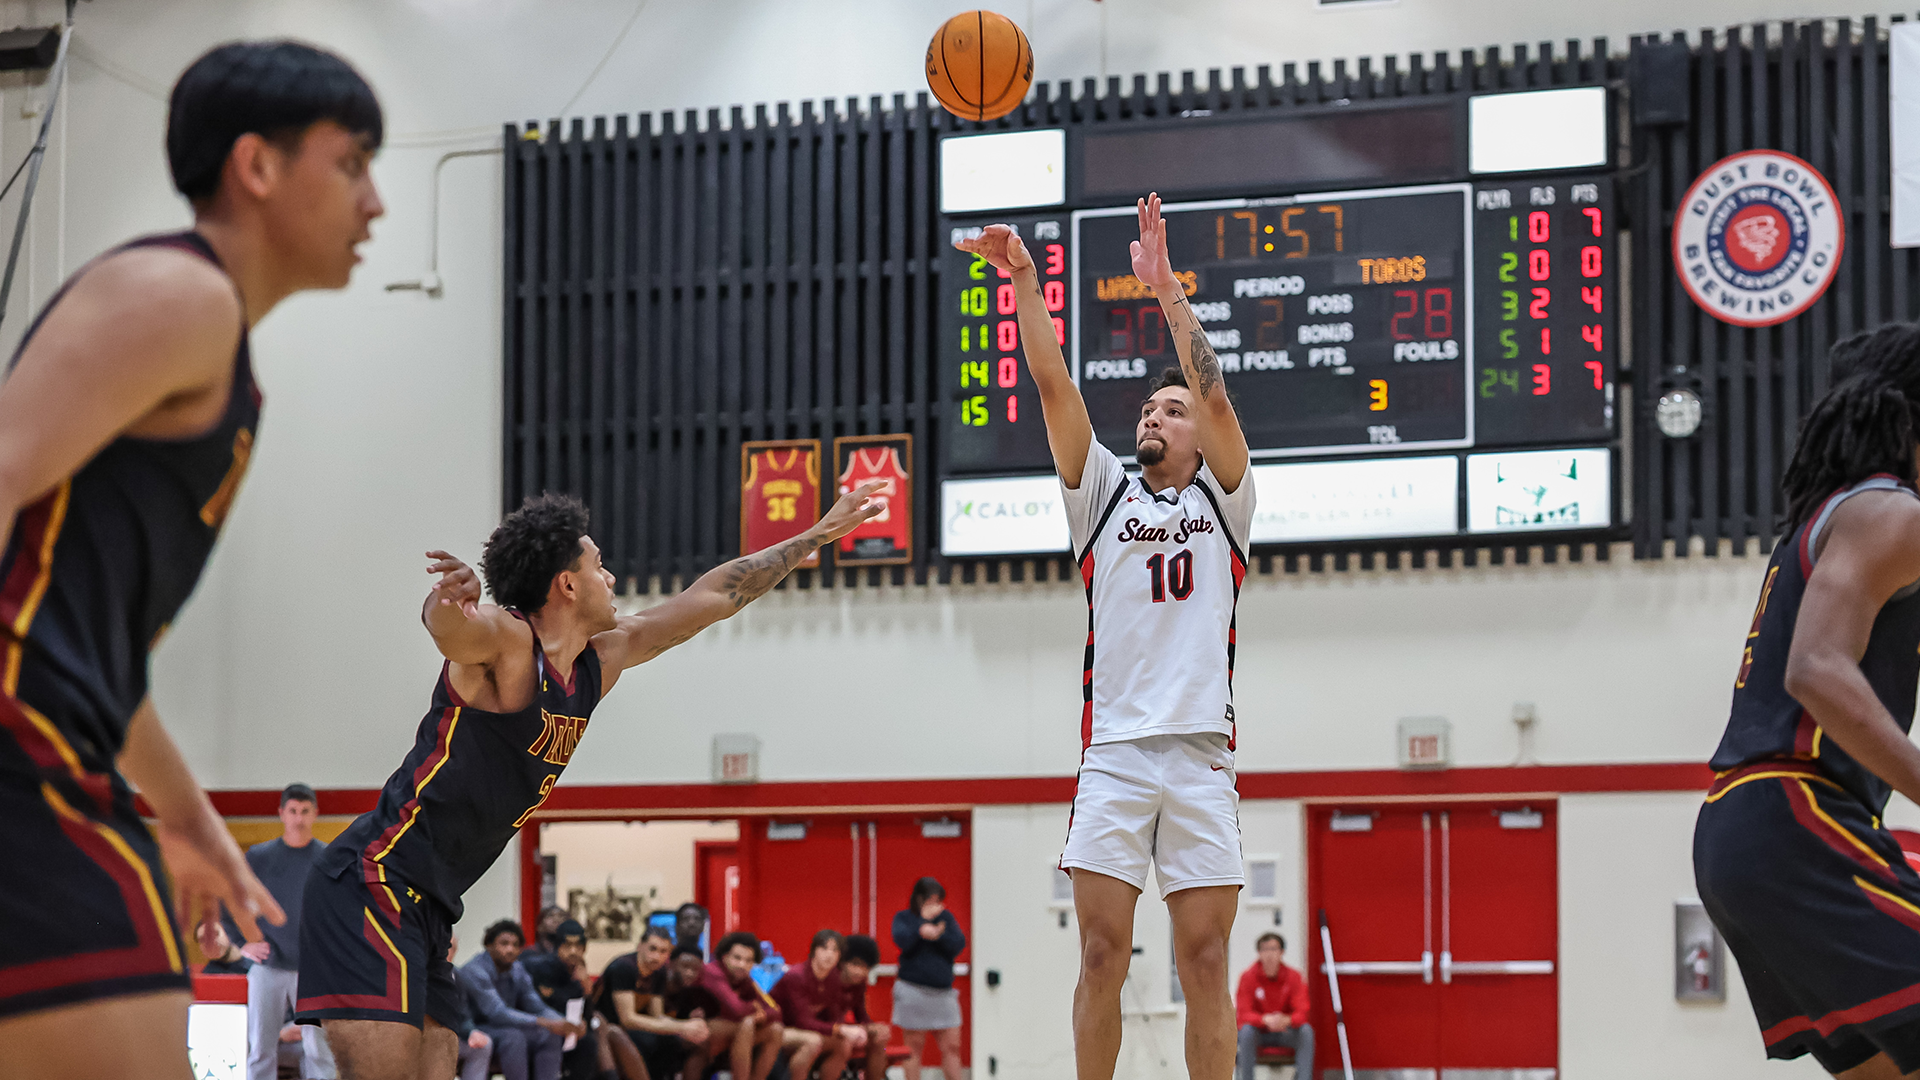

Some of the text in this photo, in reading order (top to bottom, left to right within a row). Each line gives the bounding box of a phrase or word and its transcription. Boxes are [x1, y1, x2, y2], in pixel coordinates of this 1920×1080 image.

[1691, 162, 1825, 217] DUST BOWL
[1216, 204, 1343, 259] 17:57
[1509, 207, 1602, 243] 1 0 7
[1045, 244, 1065, 275] 3
[1357, 255, 1426, 285] TOROS
[1499, 245, 1602, 283] 2 0 0
[1234, 275, 1305, 298] PERIOD
[1685, 243, 1794, 313] BREWING
[960, 280, 1065, 317] 10 0 0
[1307, 293, 1354, 316] POSS
[1391, 287, 1453, 340] 28
[1501, 285, 1603, 321] 3 2 4
[960, 323, 989, 352] 11
[996, 320, 1018, 352] 0
[1111, 306, 1165, 357] 30
[1298, 321, 1354, 345] BONUS
[1499, 323, 1603, 359] 5 1 4
[1242, 350, 1295, 371] FOUL
[1308, 346, 1347, 368] PTS
[1393, 339, 1459, 362] FOULS
[960, 357, 1018, 389] 14 0
[1085, 357, 1147, 380] FOULS
[1480, 360, 1603, 398] 24 3 7
[961, 395, 1018, 426] 15 1
[1369, 379, 1388, 411] 3
[1118, 518, 1169, 542] Stan
[1146, 548, 1194, 603] 10
